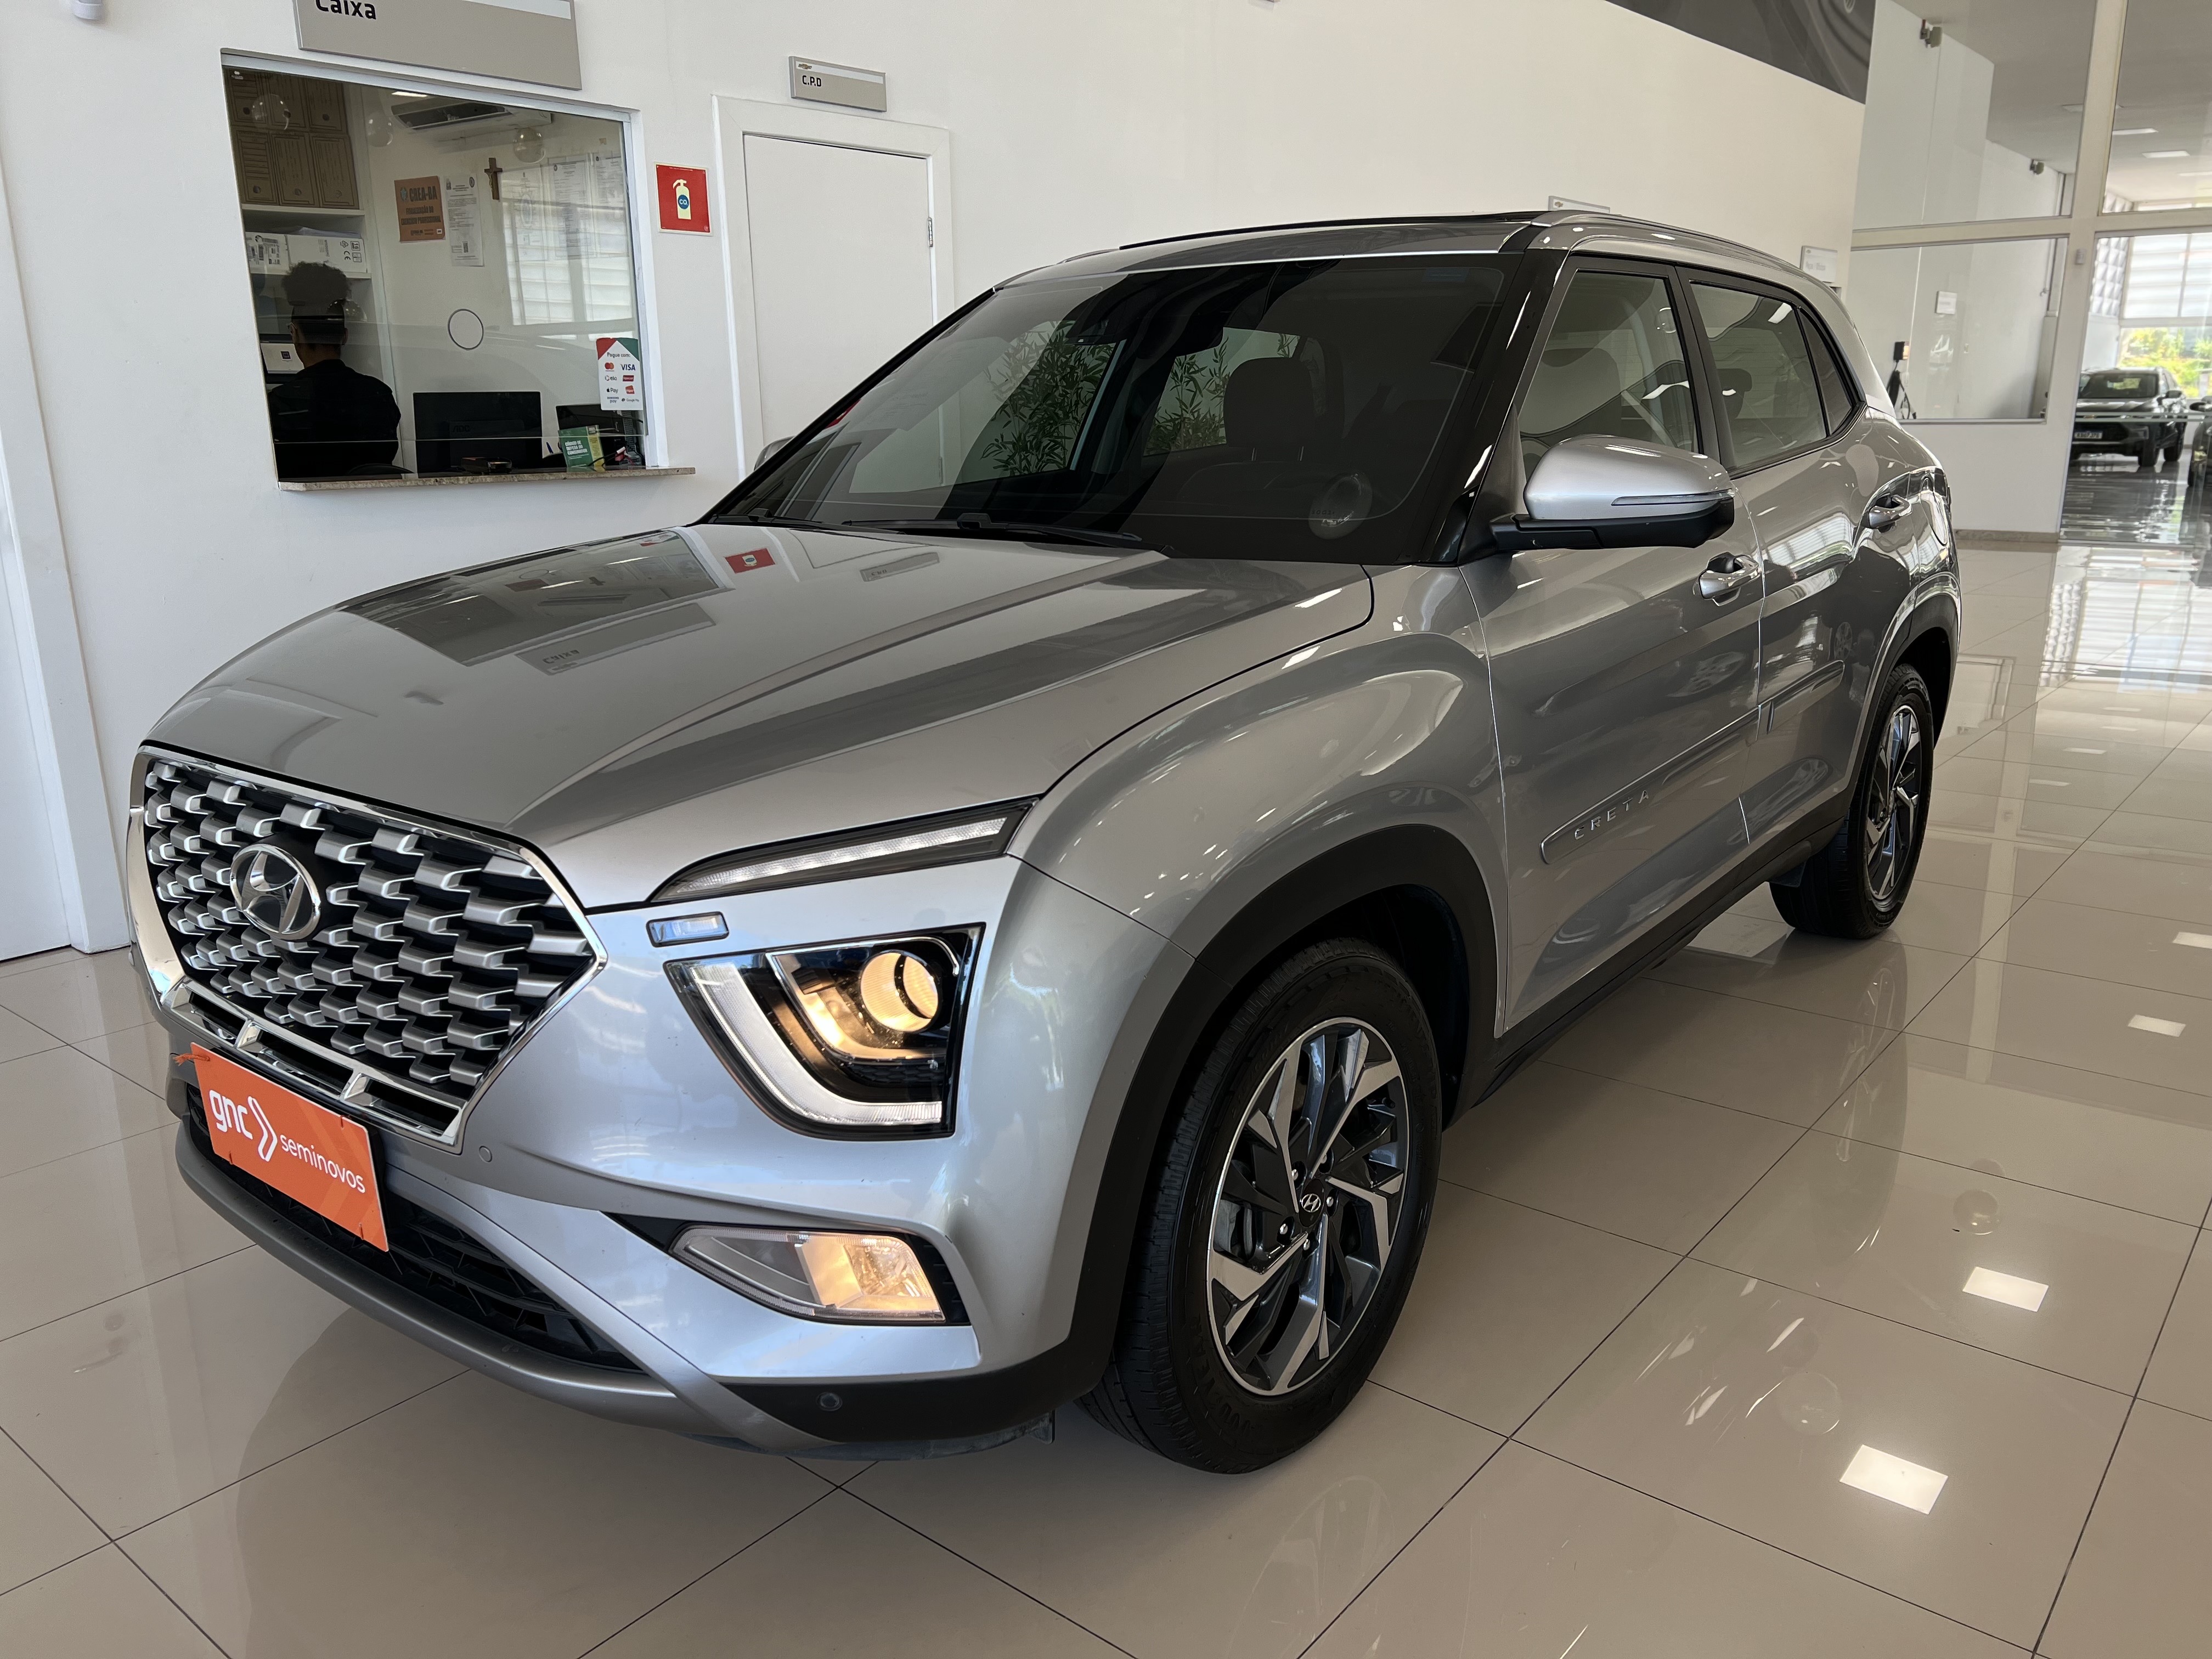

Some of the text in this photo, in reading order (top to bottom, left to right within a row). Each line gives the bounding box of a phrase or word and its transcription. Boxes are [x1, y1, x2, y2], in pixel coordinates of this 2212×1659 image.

[315, 0, 376, 20] Caixa
[802, 75, 822, 87] C.P.D
[409, 185, 438, 202] CREA-BA
[1575, 790, 1649, 840] CRETA
[208, 1090, 365, 1193] gnc seminovos
